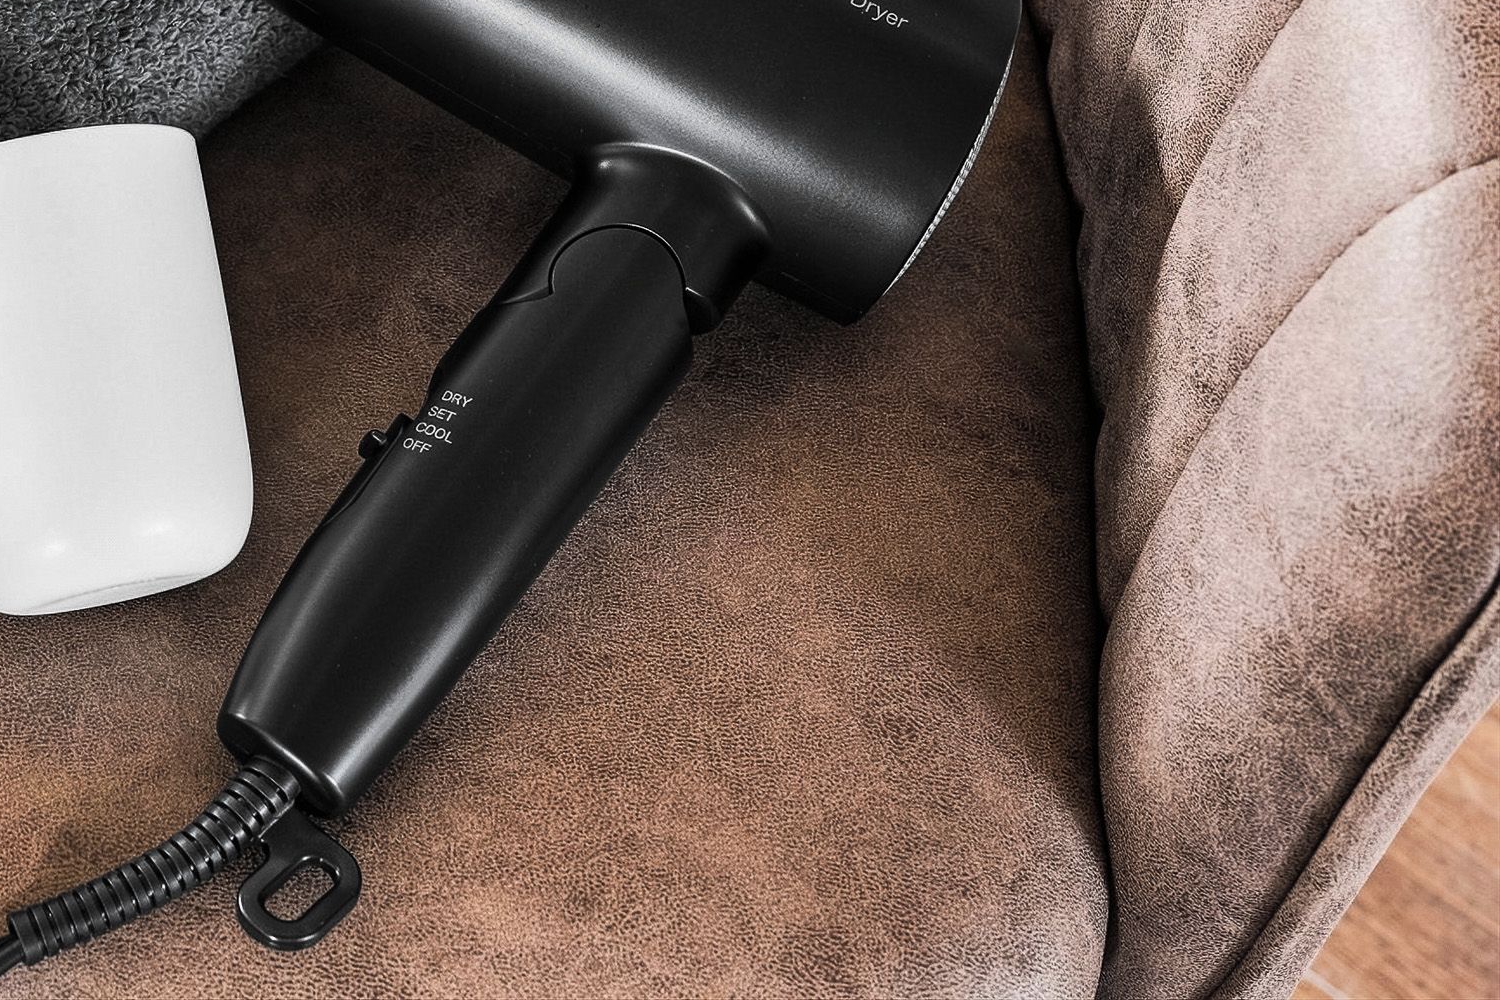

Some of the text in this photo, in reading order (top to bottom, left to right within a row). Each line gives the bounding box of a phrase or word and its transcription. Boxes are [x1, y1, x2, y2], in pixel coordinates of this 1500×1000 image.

[441, 390, 474, 408] DRY
[427, 405, 457, 422] SET
[415, 422, 453, 444] COOL
[402, 437, 432, 454] OFF
